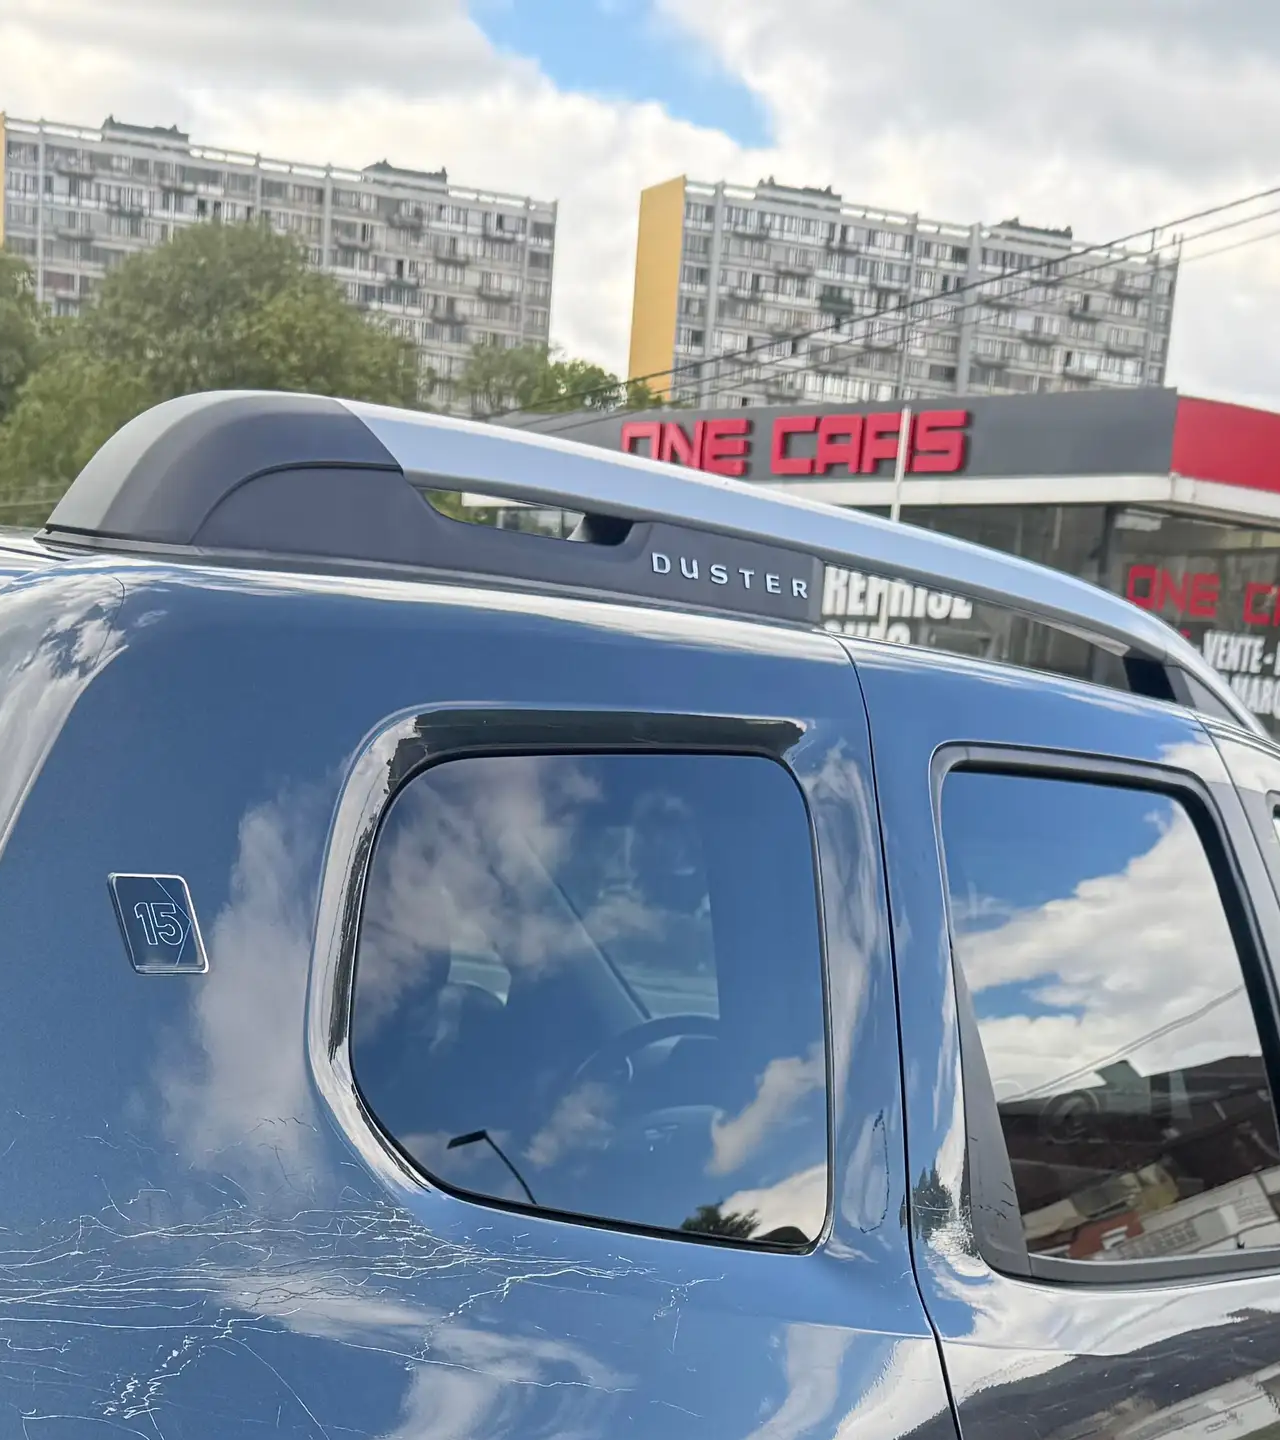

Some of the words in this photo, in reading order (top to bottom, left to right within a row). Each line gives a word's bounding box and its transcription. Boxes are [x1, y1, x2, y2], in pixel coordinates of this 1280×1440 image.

[622, 419, 750, 476] ONE
[770, 410, 967, 475] CARS
[651, 552, 809, 599] DUSTER
[1126, 564, 1219, 619] ONE
[1203, 629, 1266, 674] VENTE
[133, 901, 184, 945] 15
